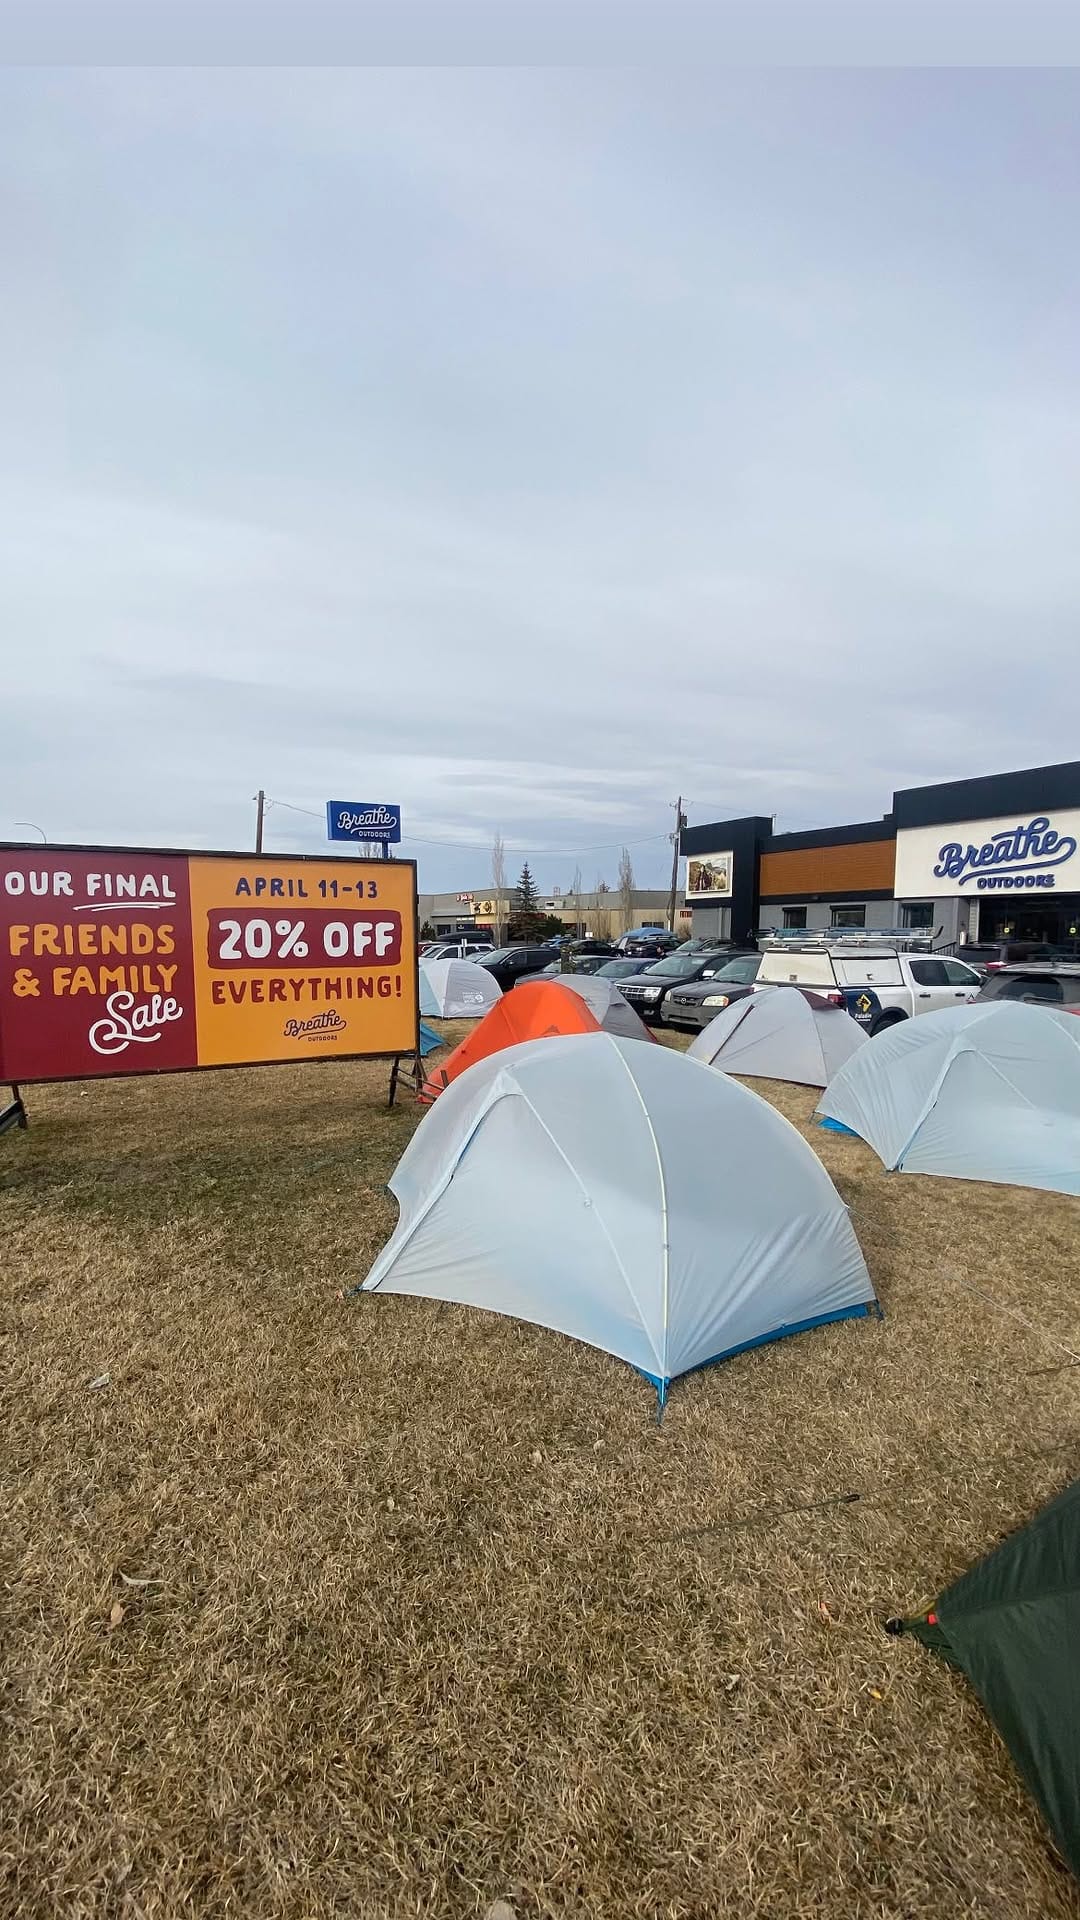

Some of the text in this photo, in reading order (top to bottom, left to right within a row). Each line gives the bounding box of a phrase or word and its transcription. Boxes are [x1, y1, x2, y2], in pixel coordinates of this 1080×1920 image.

[337, 806, 397, 834] Breathe
[358, 831, 391, 839] OUTDOORS
[933, 816, 1078, 886] Breathe
[5, 871, 176, 898] OUR FINAL
[235, 877, 378, 899] APRIL 11-13
[976, 873, 1056, 889] OUTDOORS
[8, 923, 176, 956] FRIENDS
[218, 918, 395, 961] 20% OFF
[12, 964, 178, 997] & FAMILY
[212, 975, 403, 1005] EVERYTHING!
[88, 991, 183, 1055] Sale
[283, 1009, 347, 1041] Breathe
[307, 1034, 338, 1043] OUTDOORS
